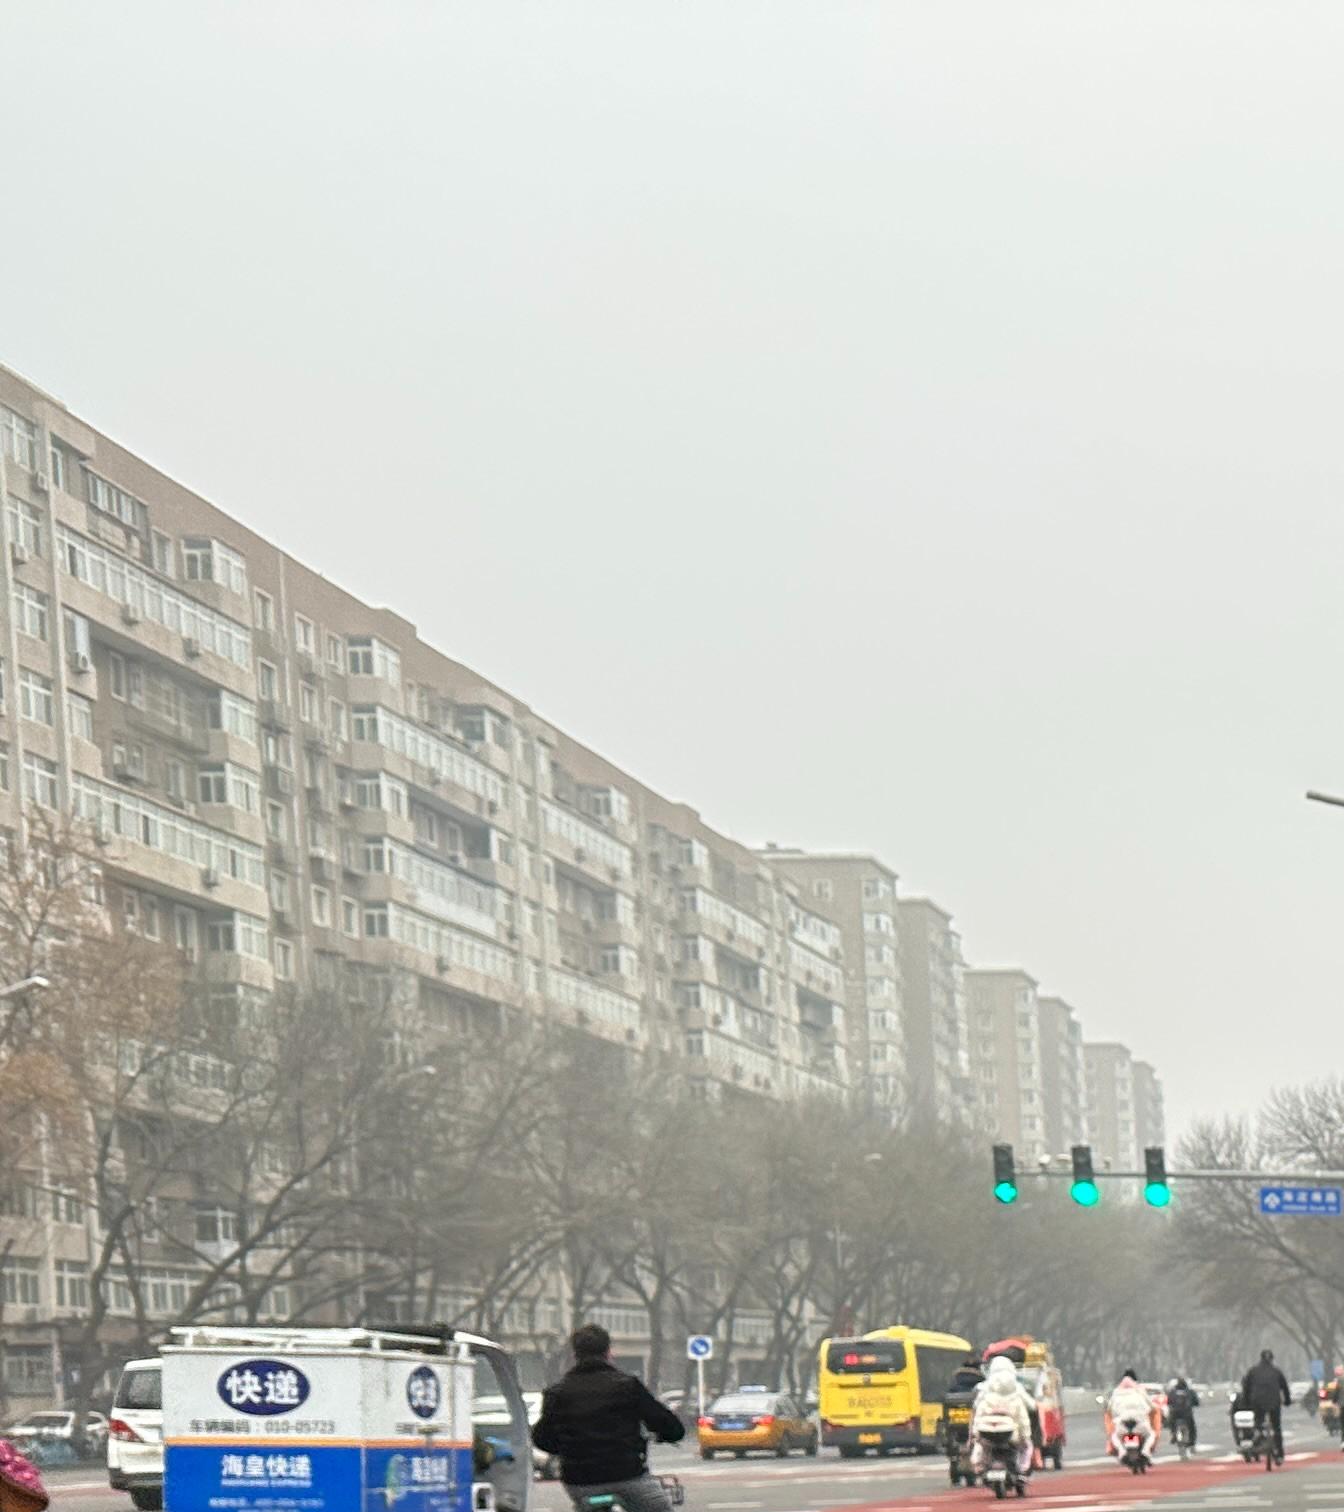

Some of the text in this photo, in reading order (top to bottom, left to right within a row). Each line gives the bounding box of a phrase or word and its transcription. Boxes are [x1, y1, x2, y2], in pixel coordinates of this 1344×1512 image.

[225, 1369, 299, 1405] 快递
[222, 1454, 312, 1478] 海皇快递
